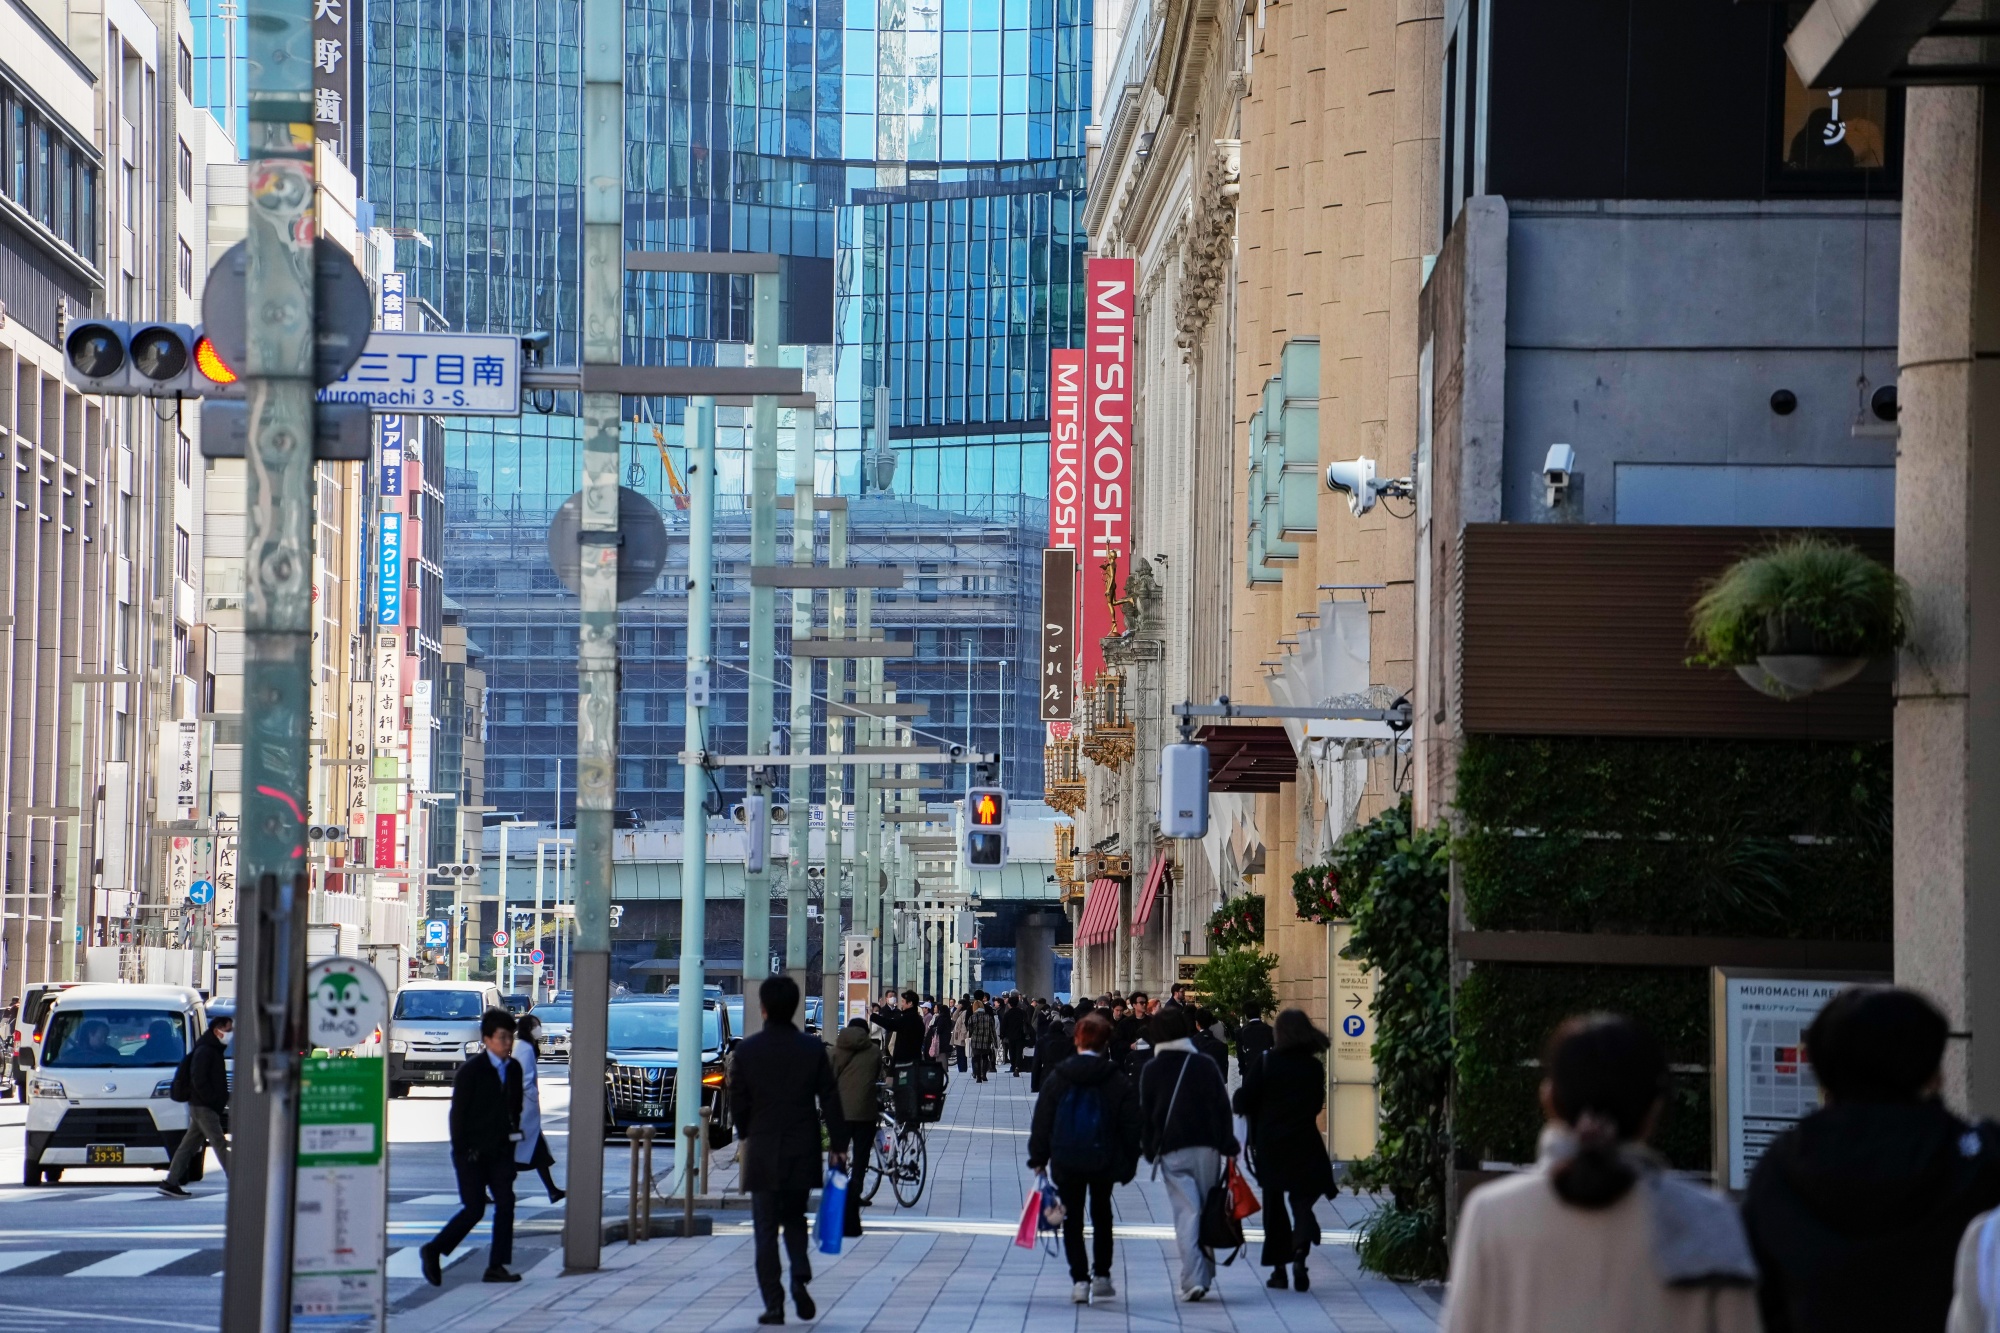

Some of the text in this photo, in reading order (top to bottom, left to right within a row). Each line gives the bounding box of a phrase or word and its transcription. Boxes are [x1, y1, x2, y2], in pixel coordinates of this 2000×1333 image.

[383, 275, 403, 331] 英会話
[337, 353, 505, 388] 三丁目南
[315, 388, 415, 406] Muromachi
[423, 389, 434, 405] 3
[1093, 280, 1126, 558] MITSUKOSHI
[1054, 364, 1078, 549] MITSUKOSH
[380, 735, 393, 743] 3F
[1740, 985, 1809, 998] MUROMACHI
[94, 1151, 123, 1162] 39-95
